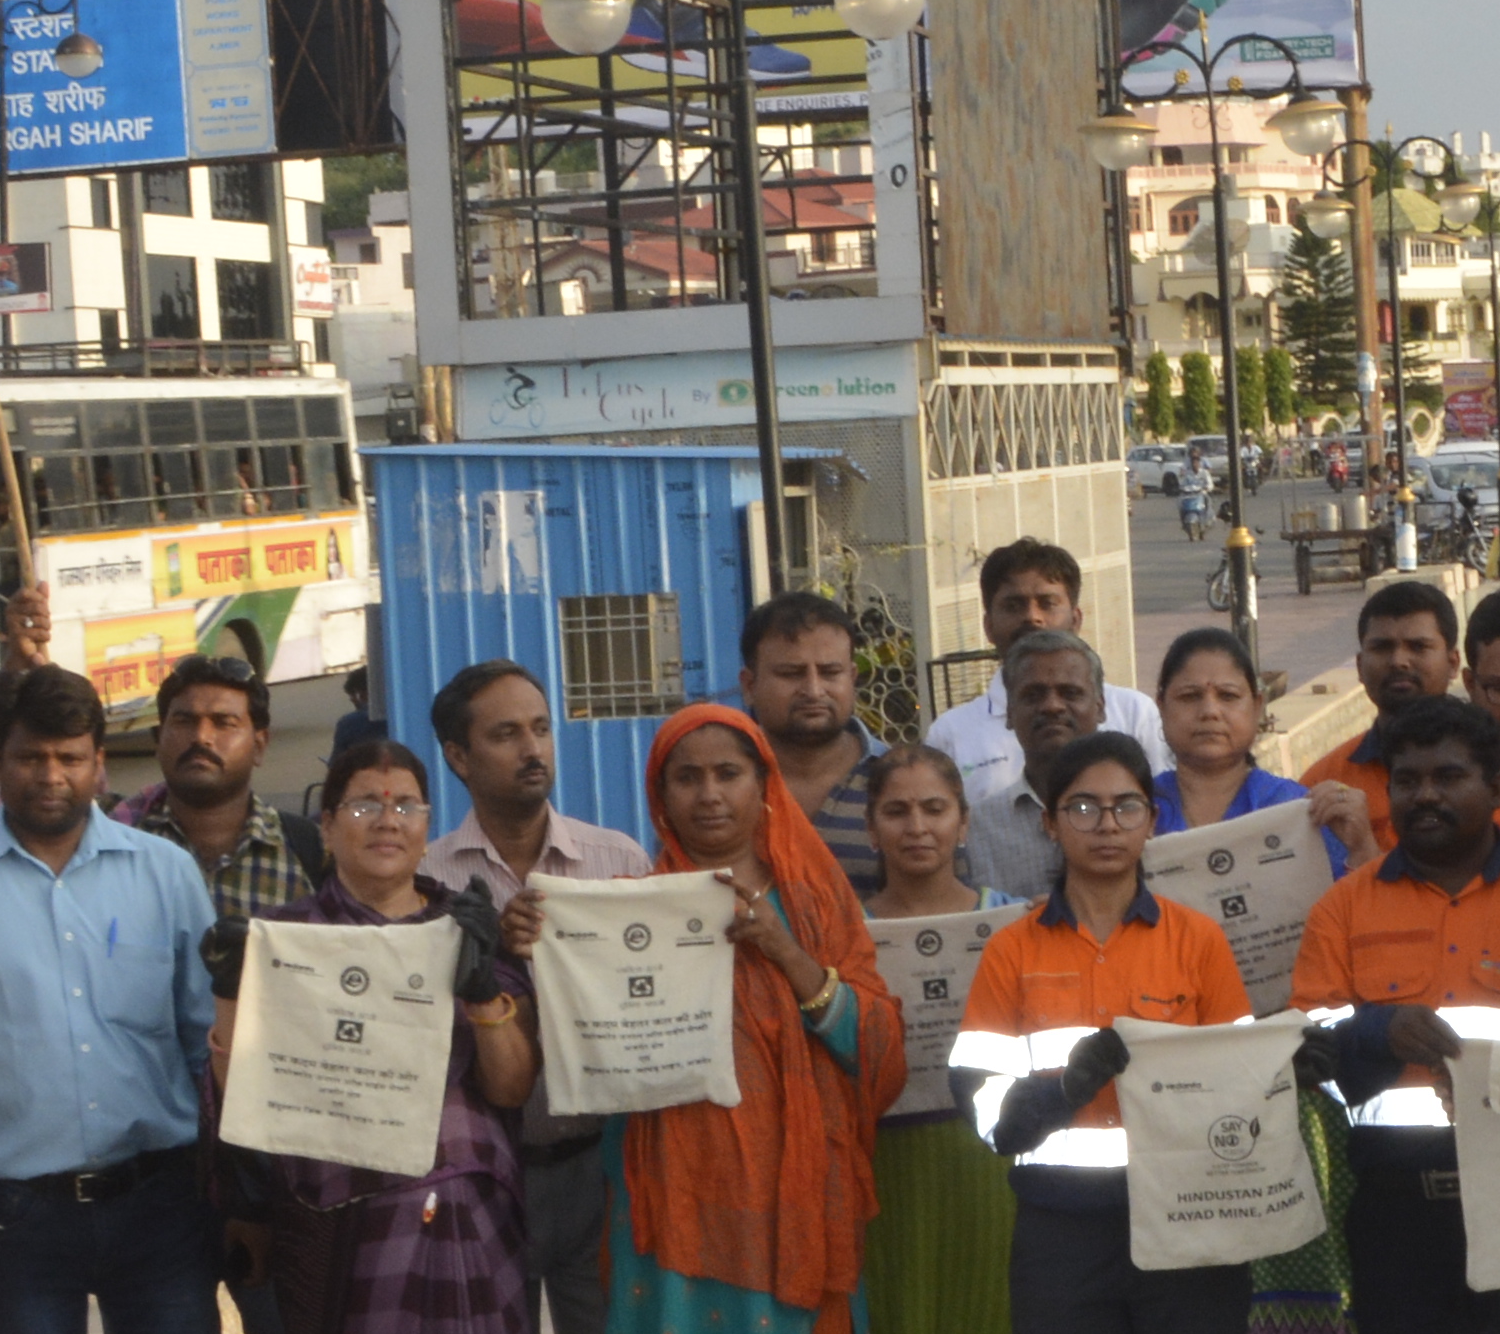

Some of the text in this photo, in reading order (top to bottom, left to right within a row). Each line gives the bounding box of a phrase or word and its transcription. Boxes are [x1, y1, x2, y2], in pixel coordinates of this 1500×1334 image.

[44, 81, 106, 114] शरीफ
[69, 118, 154, 145] SHARIF
[1221, 1121, 1243, 1133] SAY
[1177, 1178, 1295, 1203] HINDUSTAN ZINC
[1167, 1191, 1305, 1223] KAYAD MINE, AJMER
